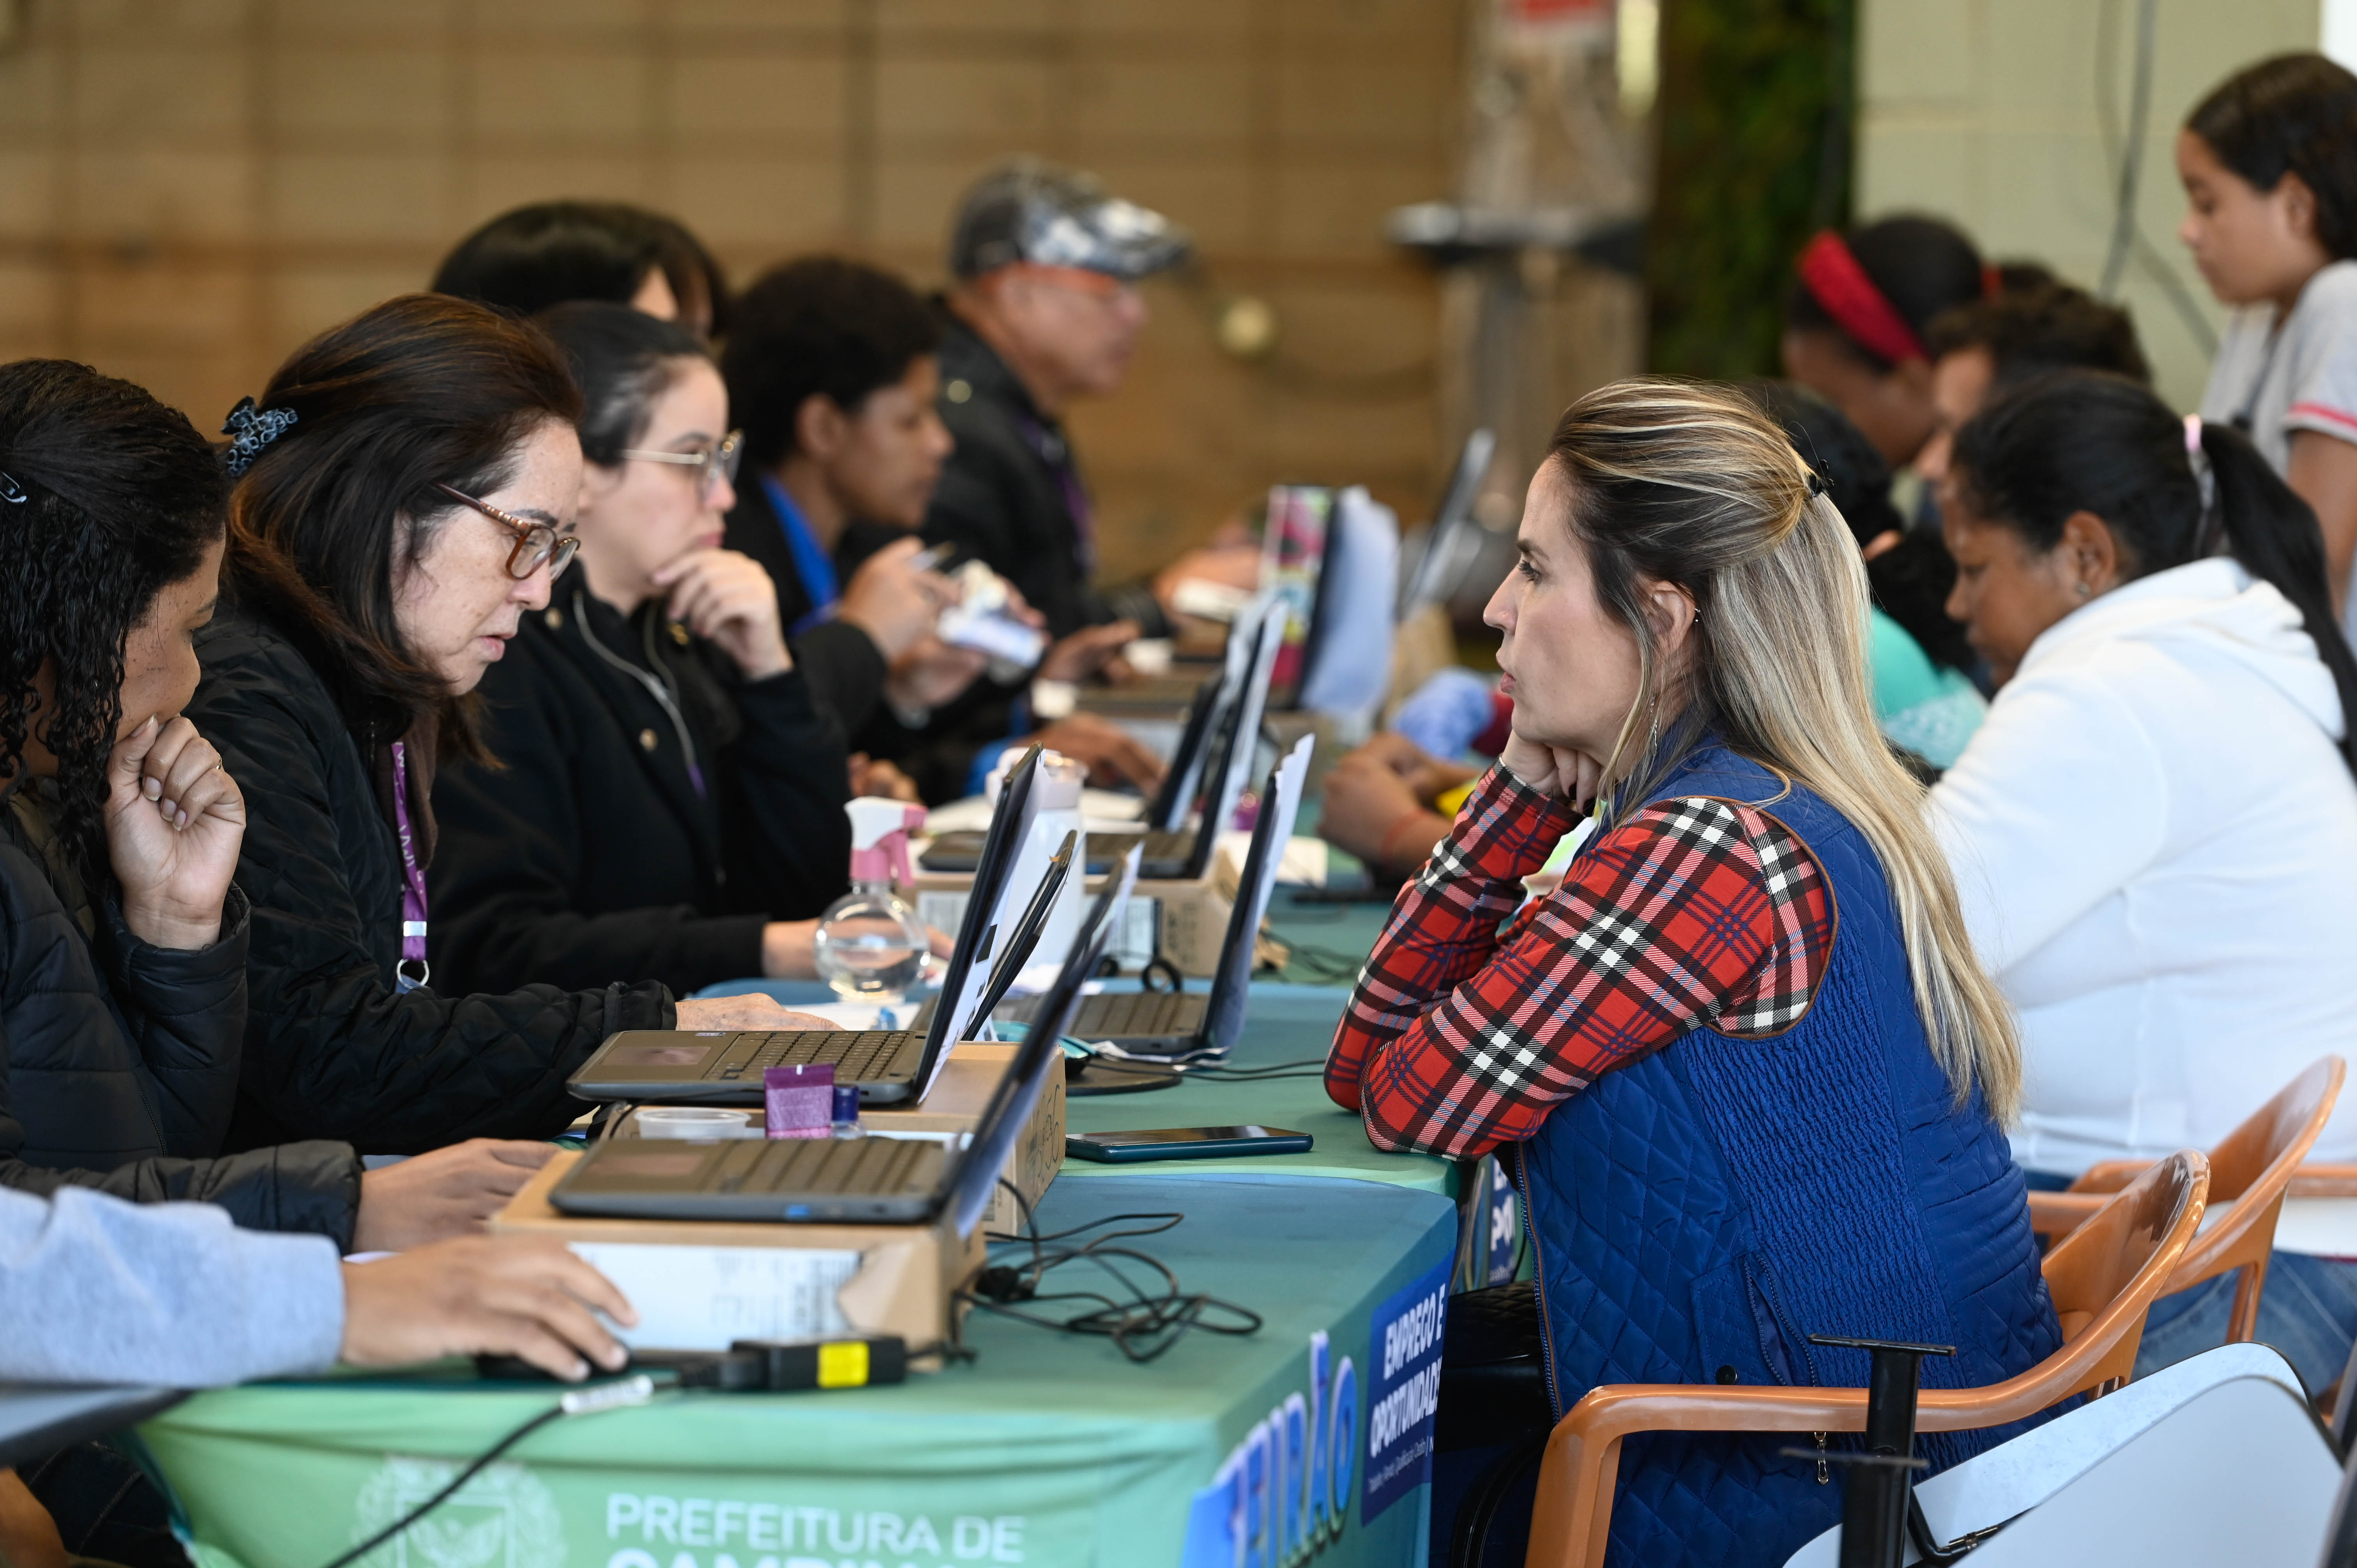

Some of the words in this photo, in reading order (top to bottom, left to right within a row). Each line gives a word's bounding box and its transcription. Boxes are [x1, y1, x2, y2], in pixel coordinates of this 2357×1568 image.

[1383, 1292, 1436, 1381] EMPREGO
[1436, 1283, 1446, 1341] E
[606, 1492, 942, 1556] PREFEITURA
[951, 1513, 1027, 1563] DE
